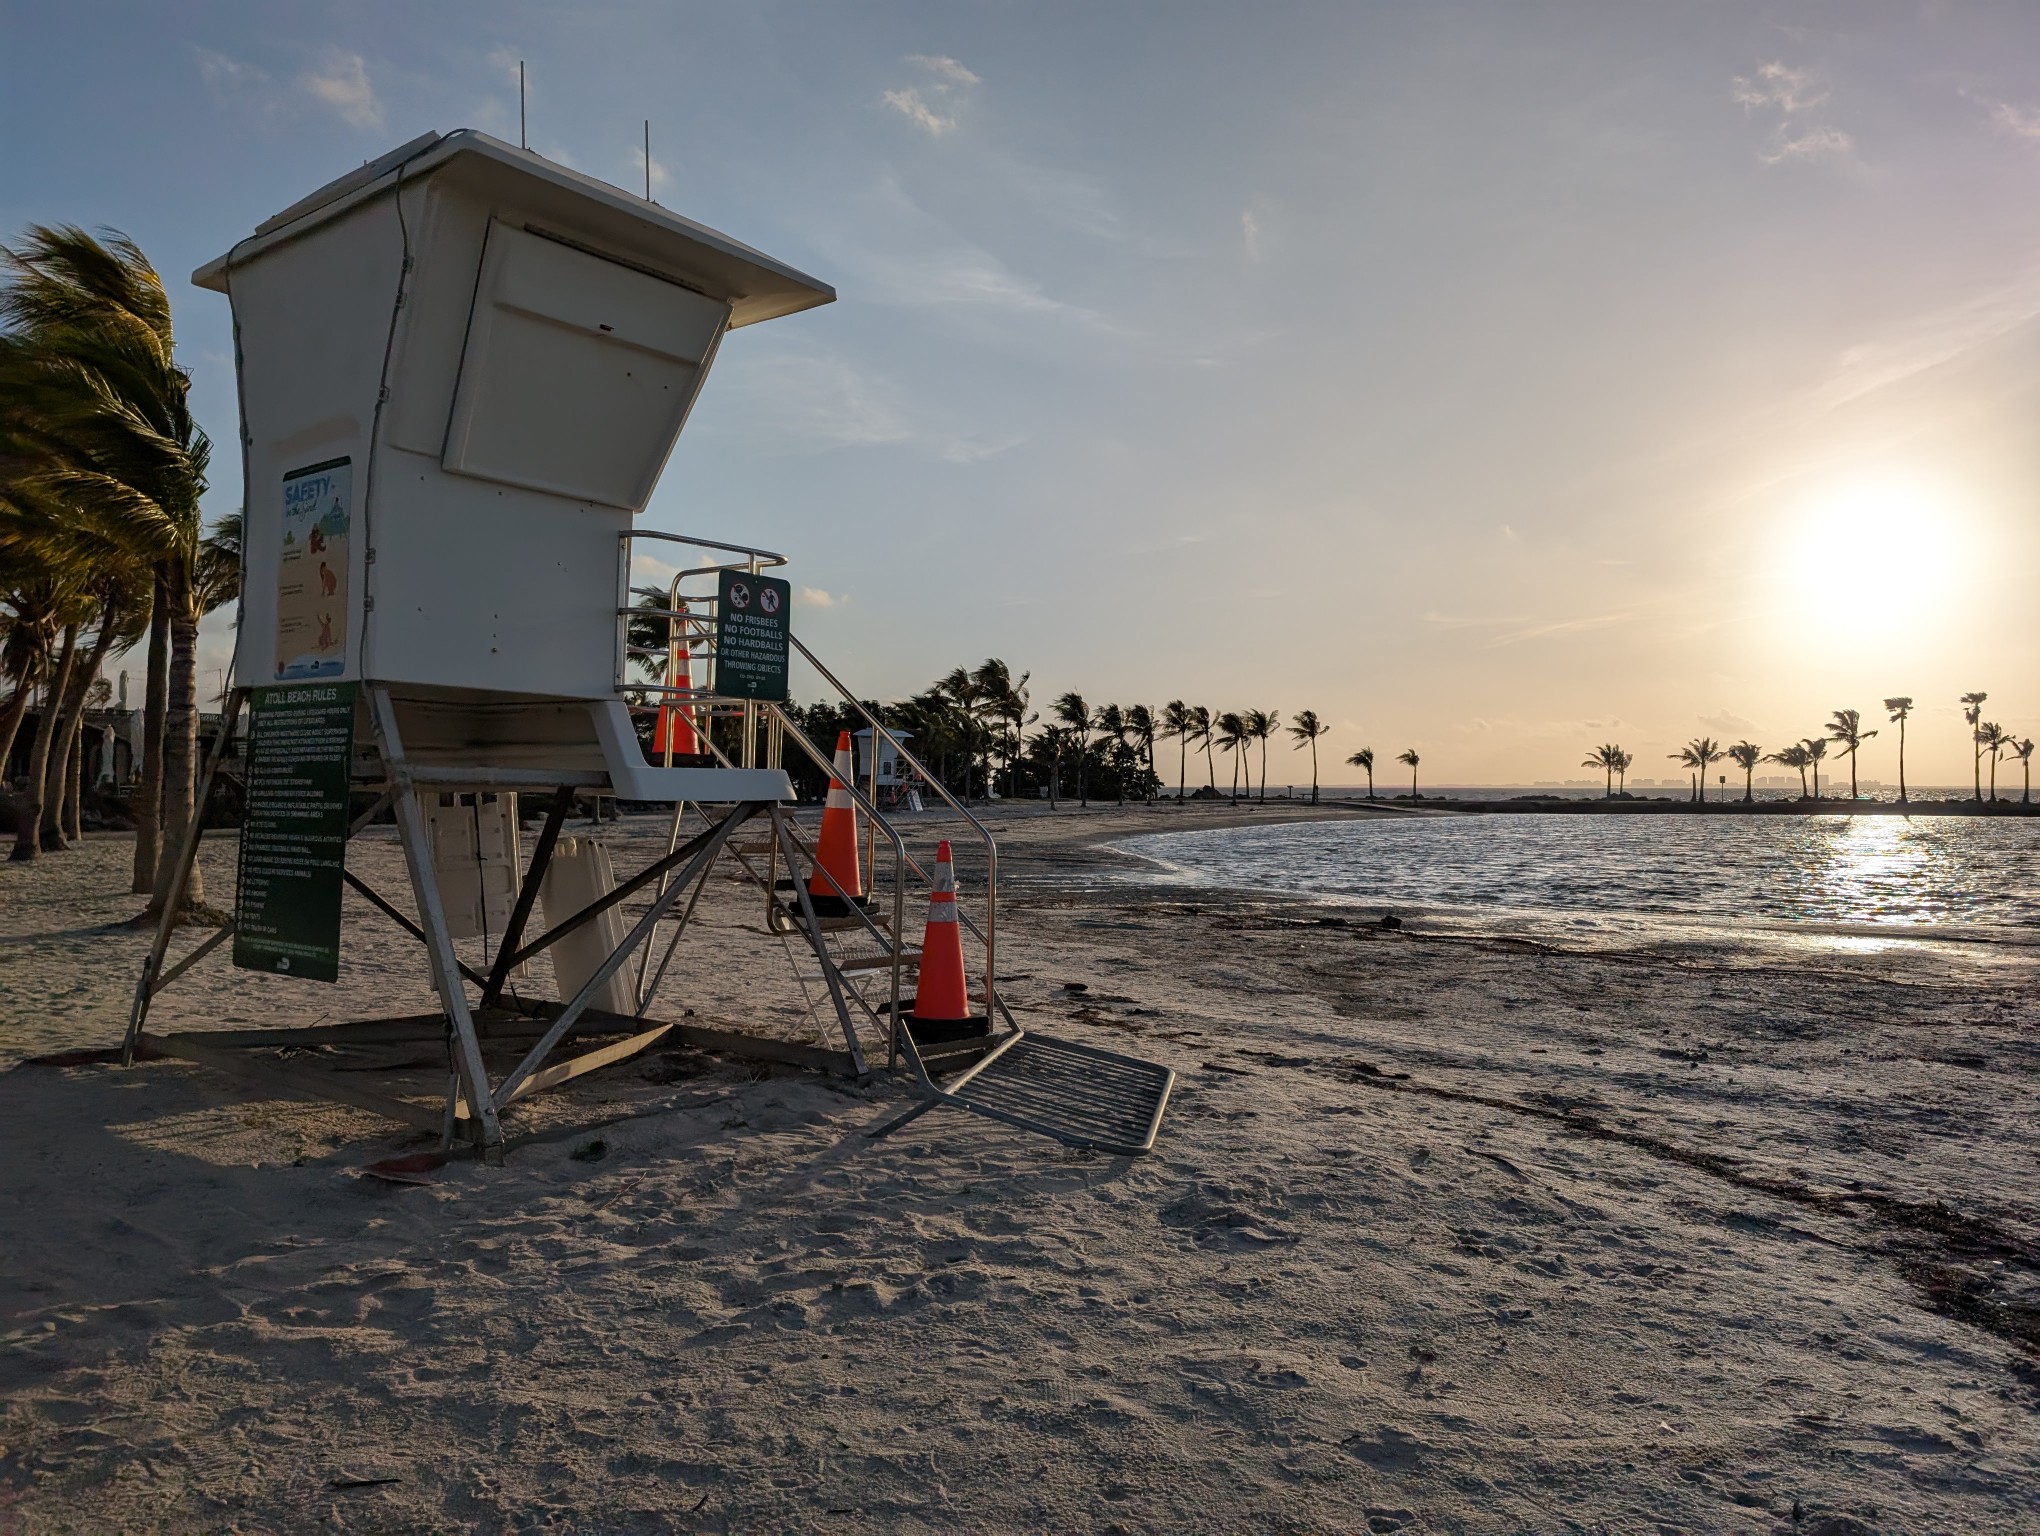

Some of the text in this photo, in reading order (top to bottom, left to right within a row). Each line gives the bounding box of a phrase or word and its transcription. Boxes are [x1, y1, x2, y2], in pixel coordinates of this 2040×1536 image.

[285, 475, 331, 505] SAFETY
[730, 613, 778, 628] NO FRISBEES
[724, 624, 783, 640] NO FOOTBALLS
[723, 635, 783, 651] NO HARDBALLS
[720, 647, 786, 663] OR OTHER HAZARDOUS
[724, 660, 782, 674] THROWING OBJECTS
[264, 688, 337, 705] ATOLL BEACH RULES
